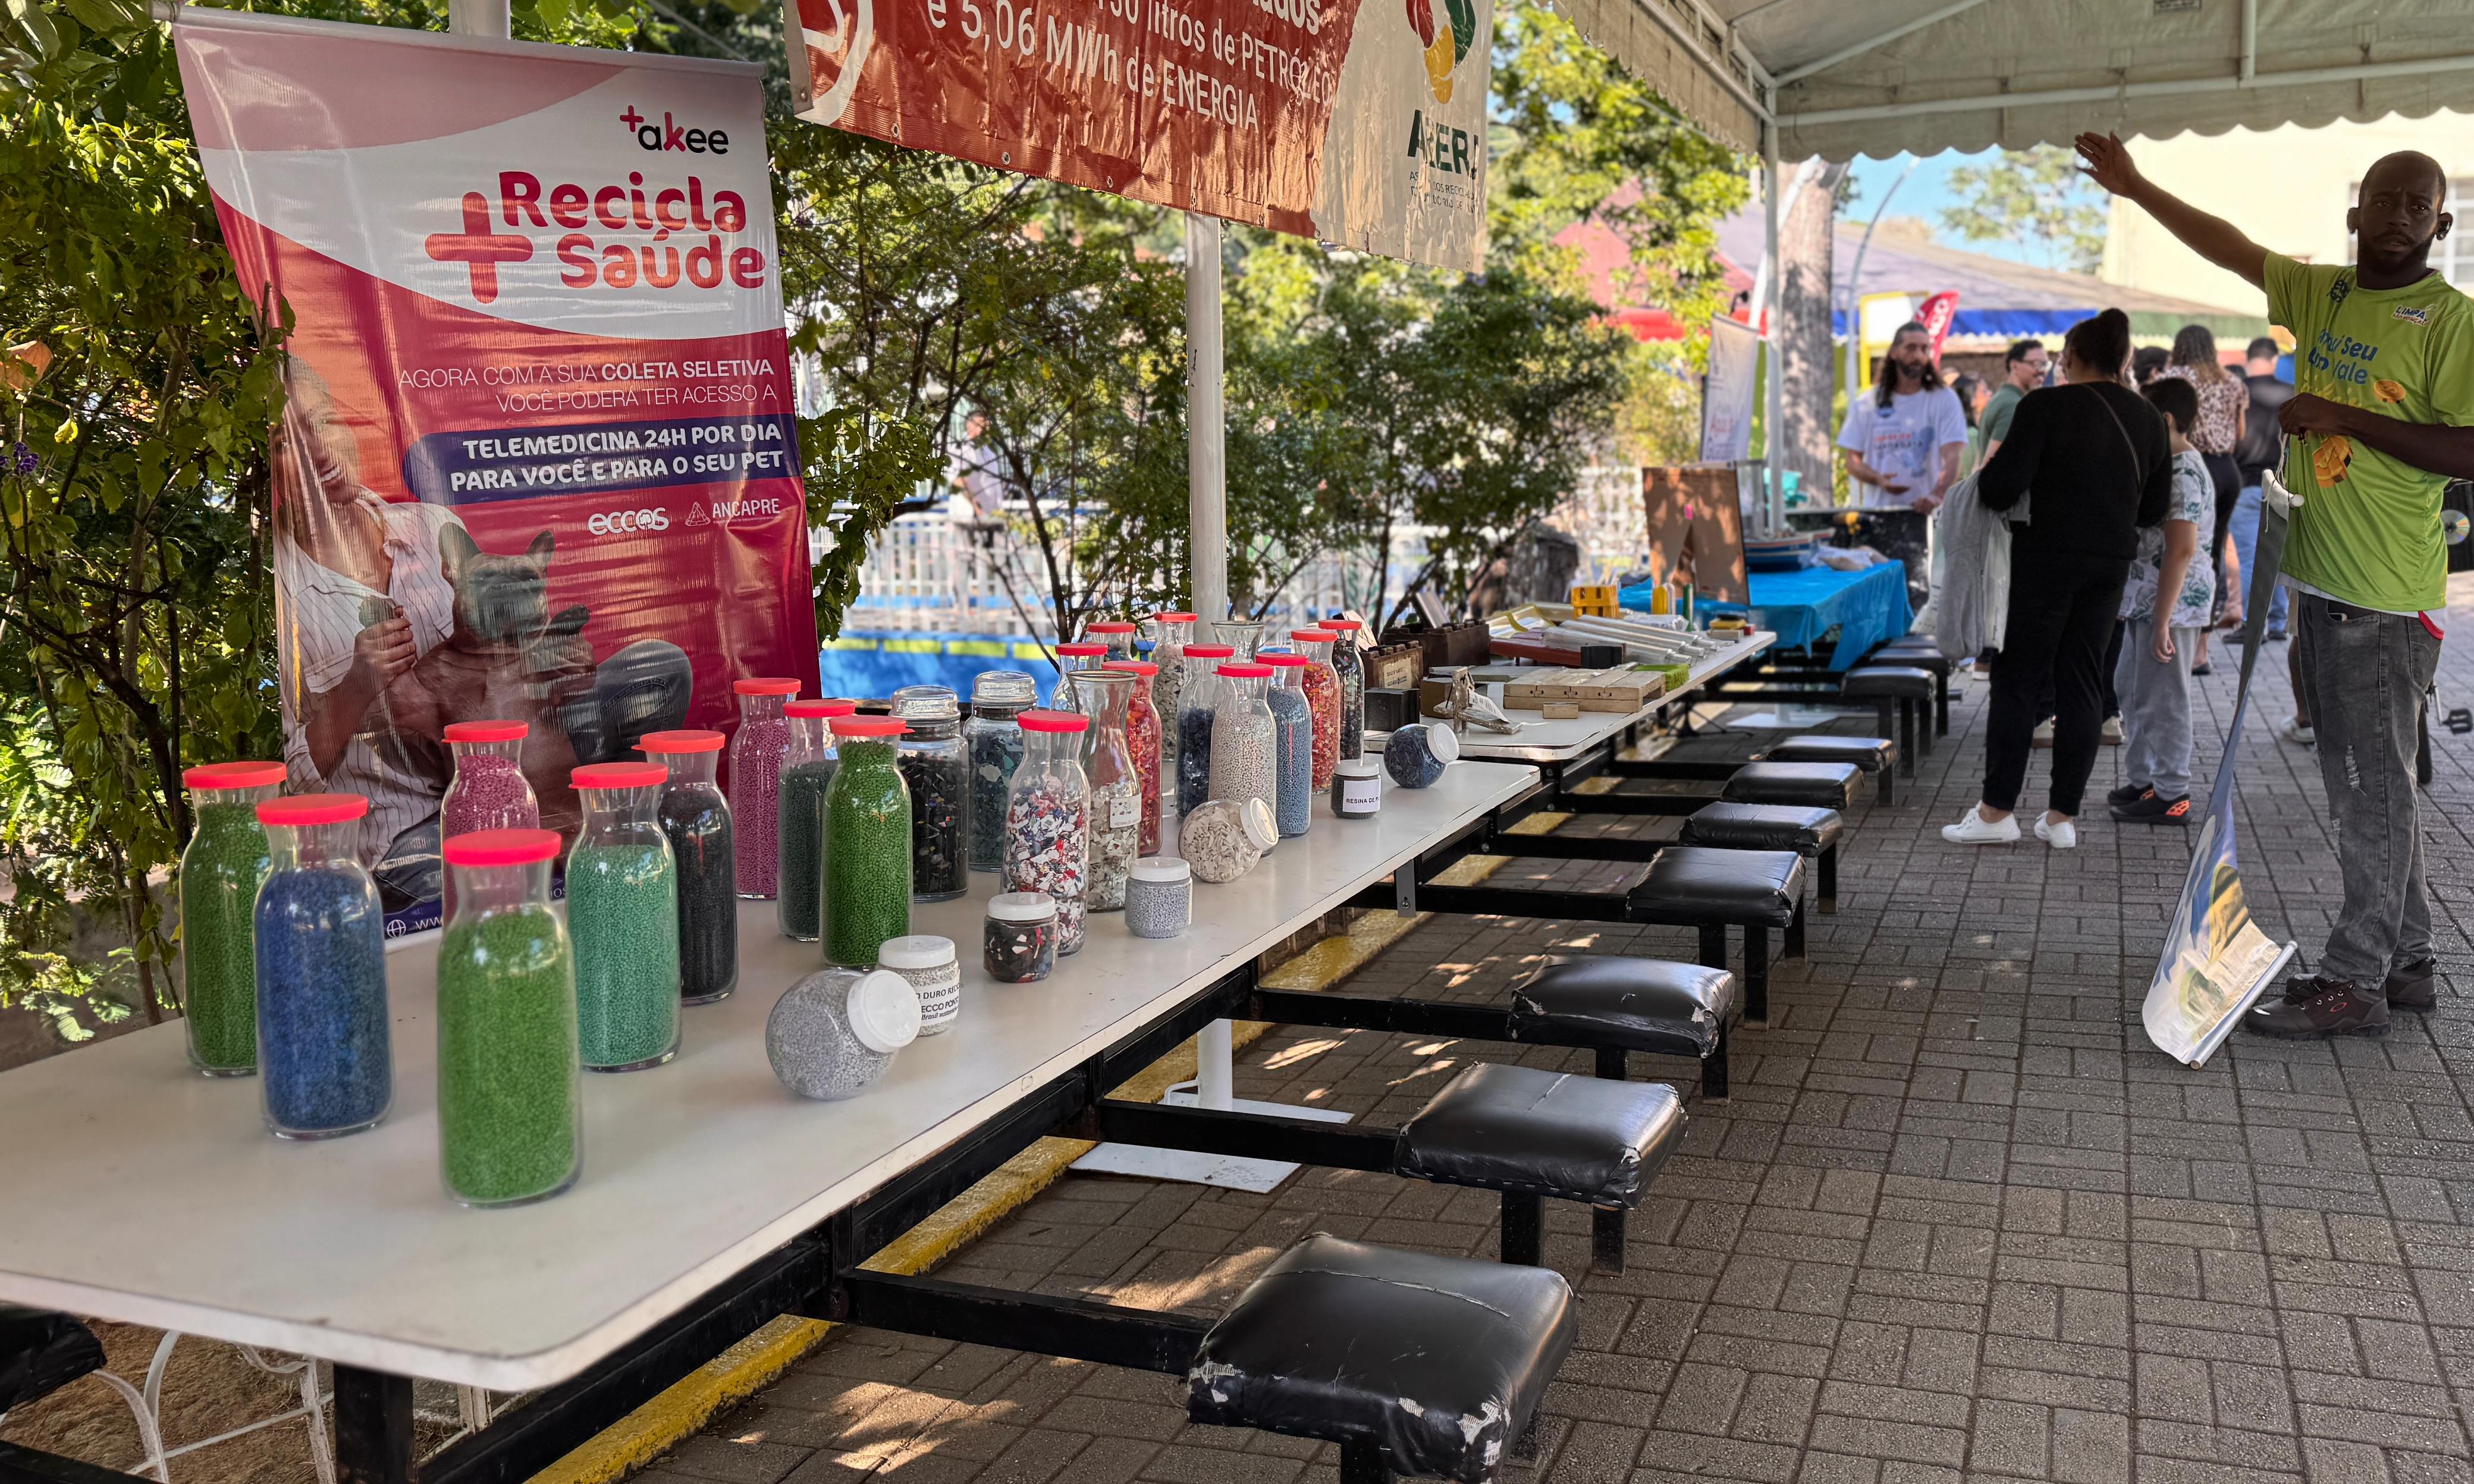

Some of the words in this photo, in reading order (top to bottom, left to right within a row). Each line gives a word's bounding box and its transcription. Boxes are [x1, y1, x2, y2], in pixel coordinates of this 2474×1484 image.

[1213, 18, 1235, 65] de
[927, 0, 947, 29] e
[960, 0, 1036, 56] 5,06
[1046, 14, 1117, 84] MWh
[1126, 46, 1154, 97] de
[1163, 59, 1259, 134] ENERGIA
[499, 171, 746, 233] Recicla
[557, 228, 766, 289] Saúde
[398, 367, 479, 389] AGORA
[483, 365, 534, 385] COM
[539, 365, 553, 383] A
[558, 364, 598, 383] SUA
[601, 361, 679, 381] COLETA
[683, 359, 774, 378] SELETIVA
[495, 389, 554, 413] VOCÊ
[558, 385, 639, 410] PODERÁ
[642, 388, 678, 405] TER
[682, 385, 758, 404] ACESSO
[763, 384, 777, 401] A
[463, 431, 641, 460] TELEMEDICINA
[644, 427, 686, 449] 24H
[691, 425, 736, 445] POR
[740, 423, 782, 442] DIA
[450, 468, 517, 492] PARA
[521, 458, 586, 486] VOCÊ
[591, 462, 606, 481] E
[610, 458, 668, 479] PARA
[673, 456, 688, 474] O
[693, 452, 736, 473] SEU
[741, 451, 783, 470] PET
[588, 507, 670, 535] eccos
[713, 498, 781, 518] ANCAPRE
[921, 1003, 944, 1013] ECCO
[923, 989, 946, 999] DURO
